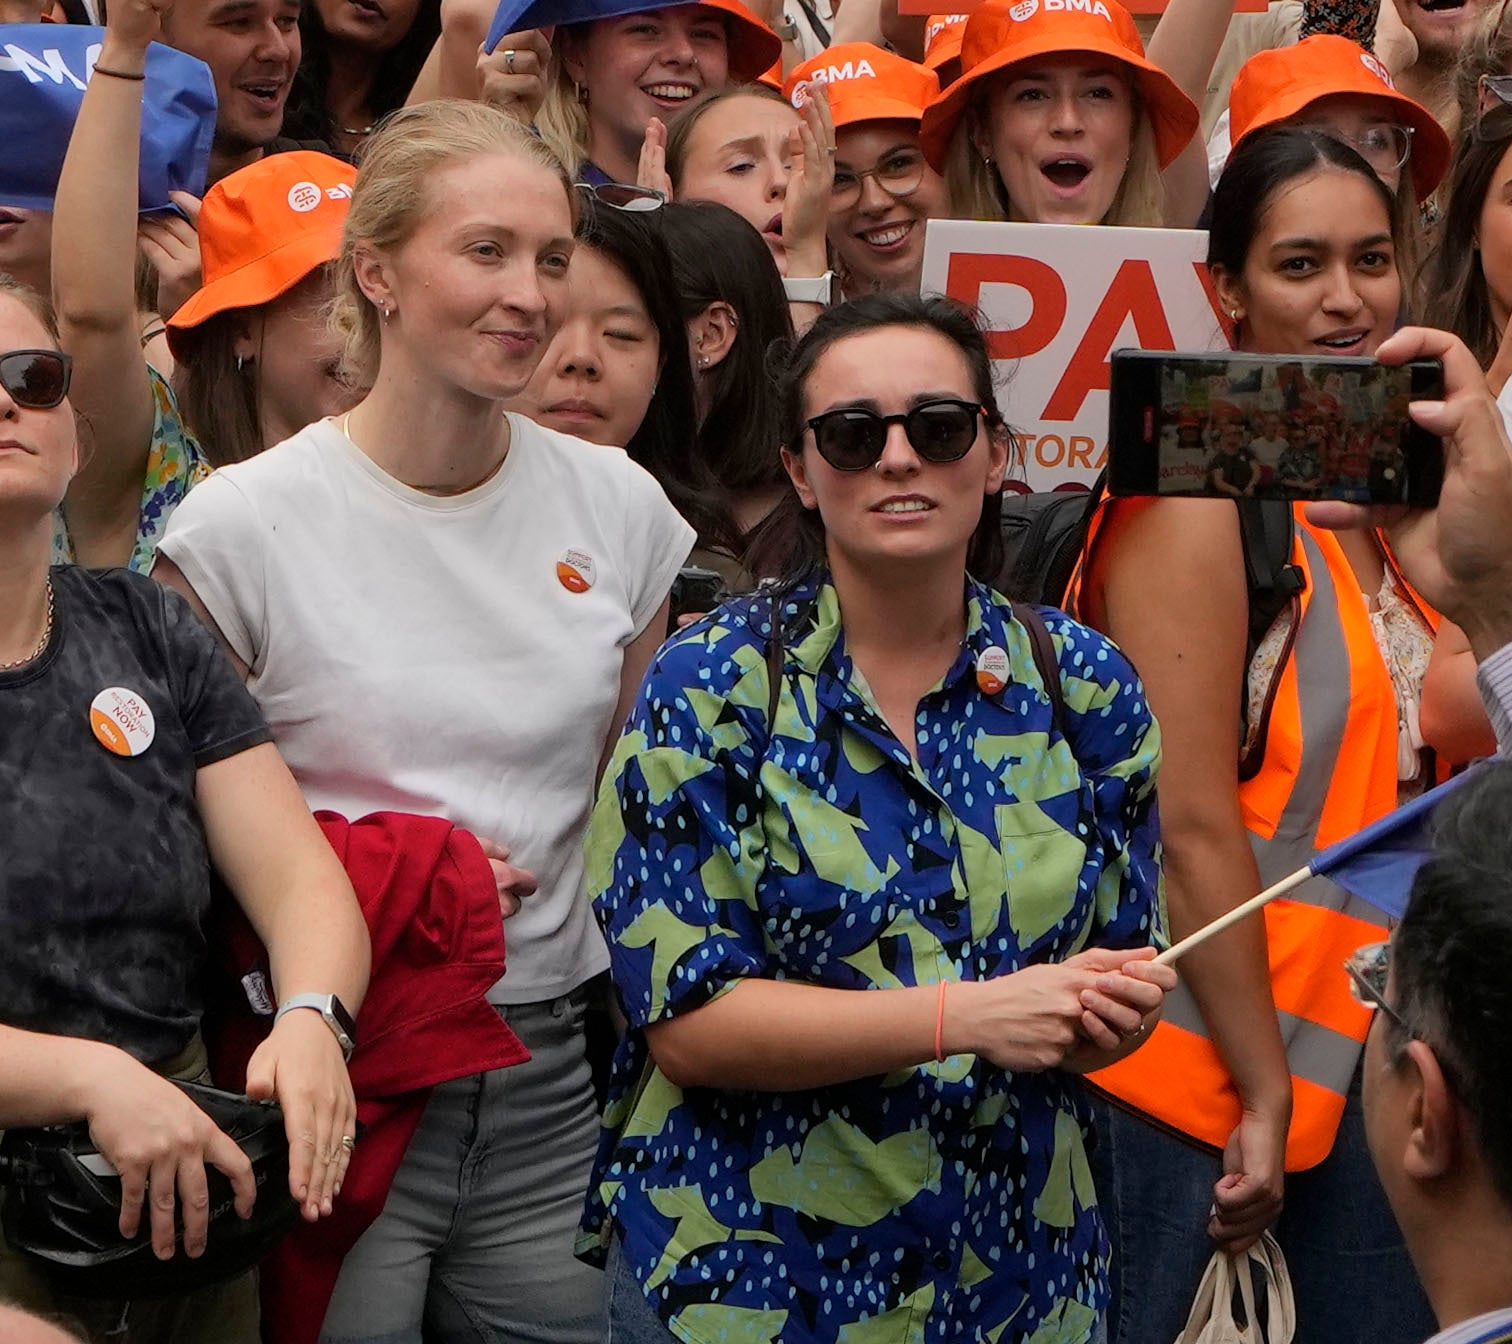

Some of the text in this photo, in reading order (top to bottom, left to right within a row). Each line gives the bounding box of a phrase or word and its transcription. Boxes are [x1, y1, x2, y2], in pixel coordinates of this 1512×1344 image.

[811, 59, 876, 84] BMA
[112, 706, 137, 733] NOW
[127, 698, 146, 718] PAY
